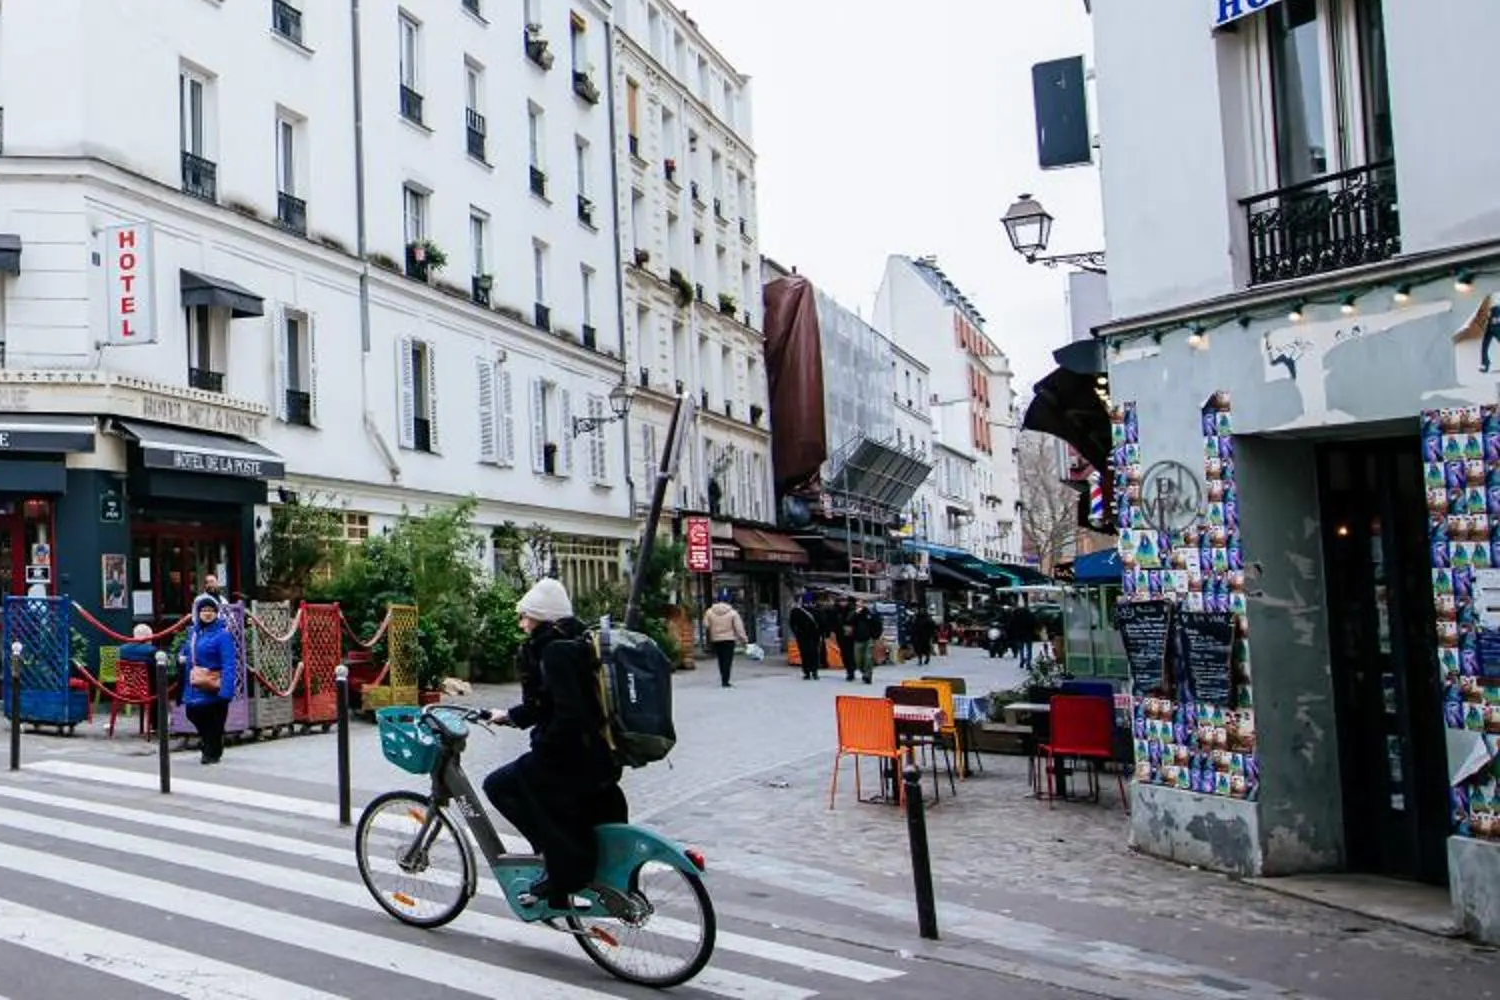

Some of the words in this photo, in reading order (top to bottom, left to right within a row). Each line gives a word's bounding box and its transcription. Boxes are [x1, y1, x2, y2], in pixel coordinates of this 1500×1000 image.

[119, 231, 136, 337] HOTEL
[143, 396, 181, 419] HOTEL
[206, 407, 223, 429] LA
[225, 412, 260, 436] POSTE
[174, 452, 204, 470] HOTEL
[206, 456, 219, 471] DE
[220, 457, 233, 473] LA
[235, 459, 262, 475] POSTE
